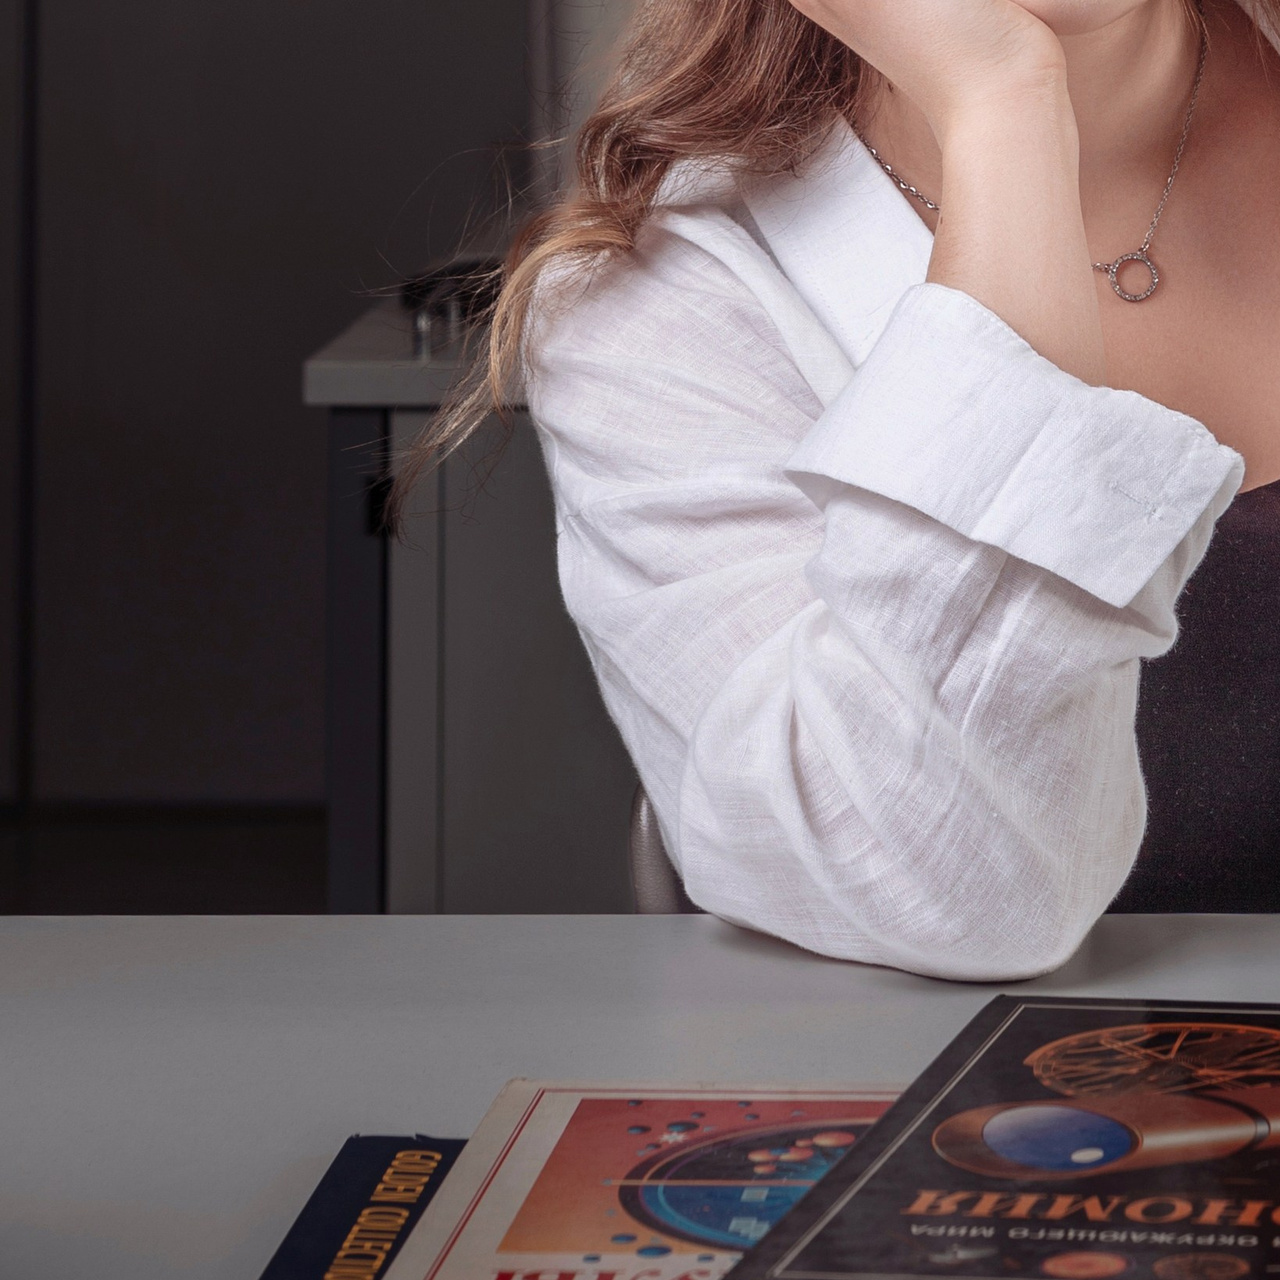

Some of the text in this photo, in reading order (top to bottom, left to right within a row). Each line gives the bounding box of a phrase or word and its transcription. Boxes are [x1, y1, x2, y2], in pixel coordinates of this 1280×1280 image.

[369, 1149, 443, 1203] GOLDEN
[910, 1224, 996, 1239] МИРА
[1007, 1227, 1259, 1248] ОКРУЖАЮЩЕГО
